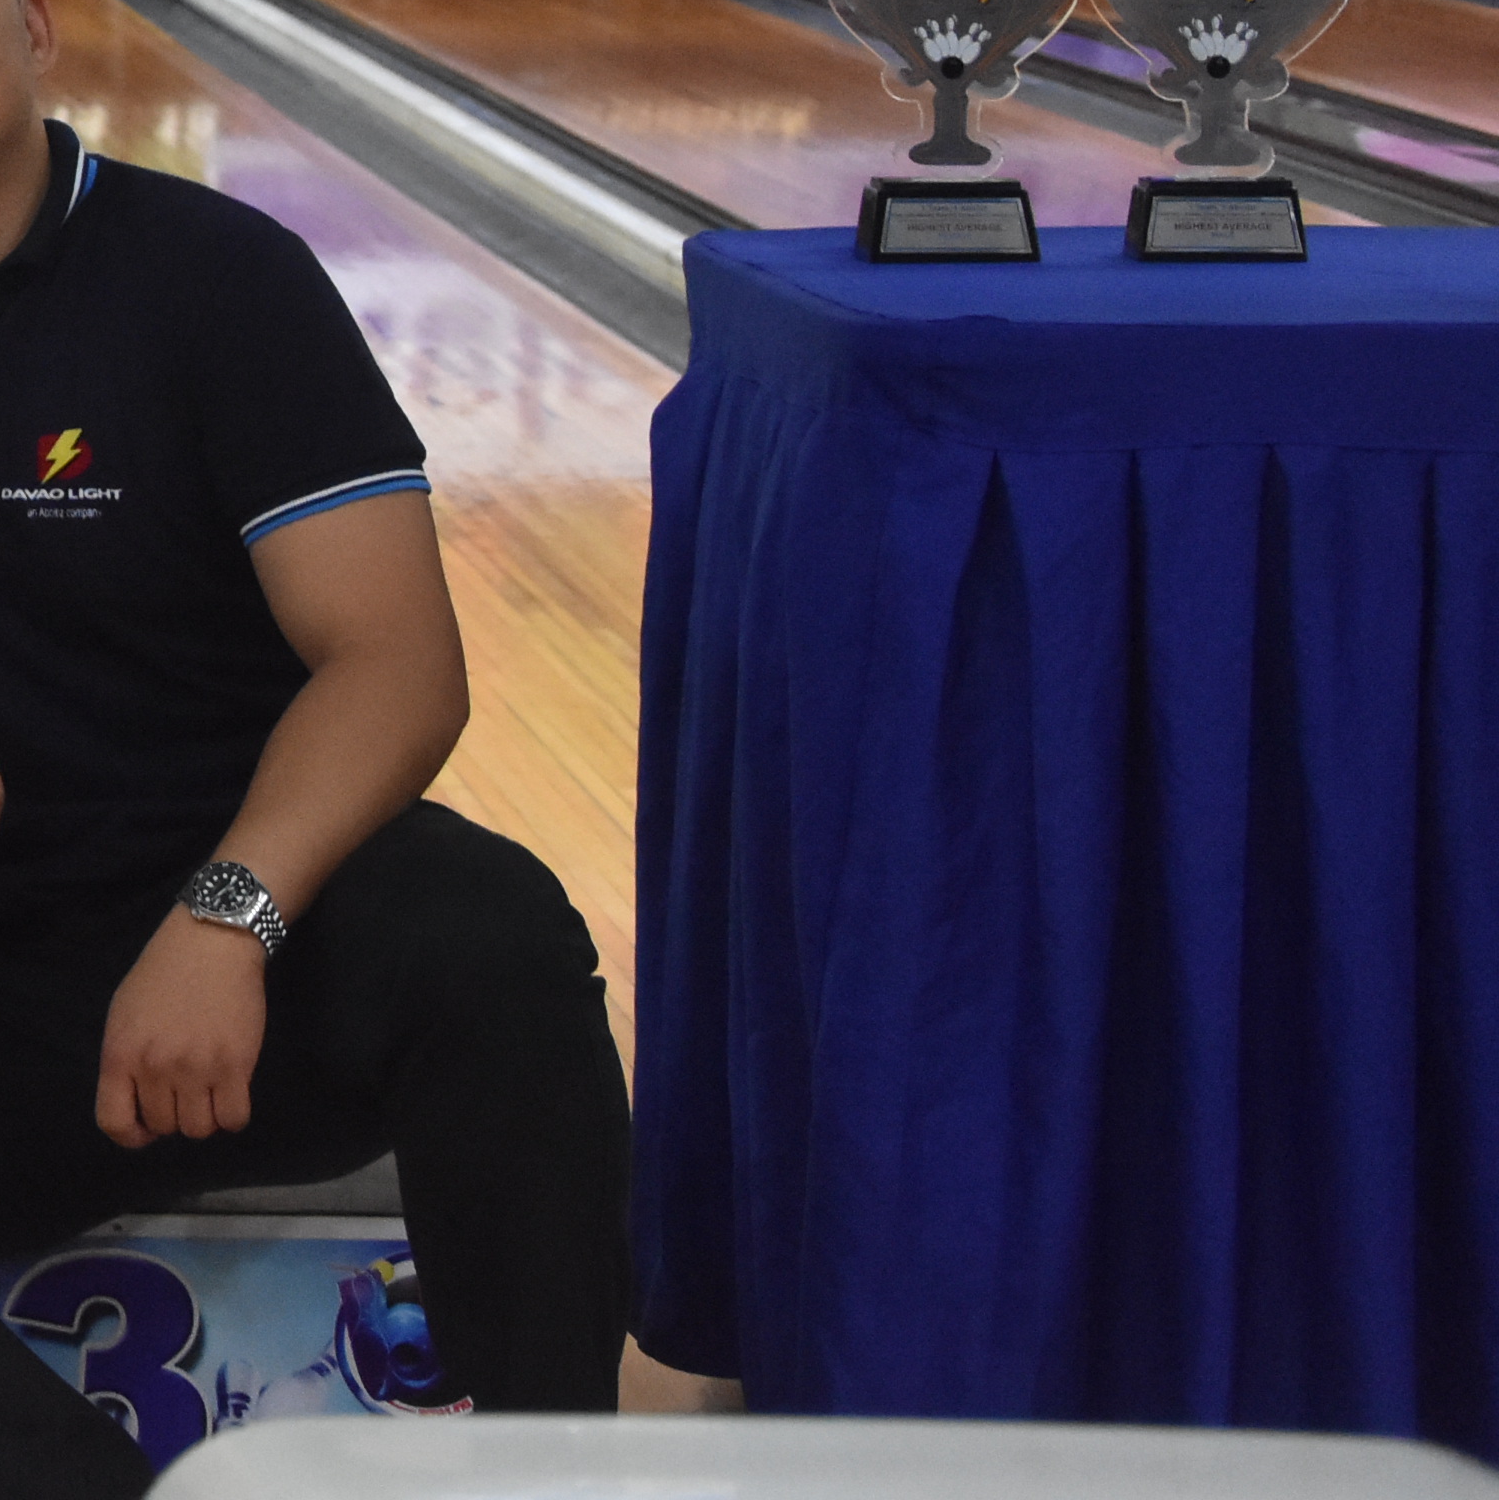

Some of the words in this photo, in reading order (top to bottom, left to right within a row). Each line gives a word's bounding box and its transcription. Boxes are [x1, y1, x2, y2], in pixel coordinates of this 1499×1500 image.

[1175, 223, 1218, 231] HIGHEST
[1221, 223, 1273, 231] AVERAGE
[1, 487, 64, 500] DAVAO
[68, 487, 122, 501] LIGHT
[1, 1247, 208, 1473] 3
